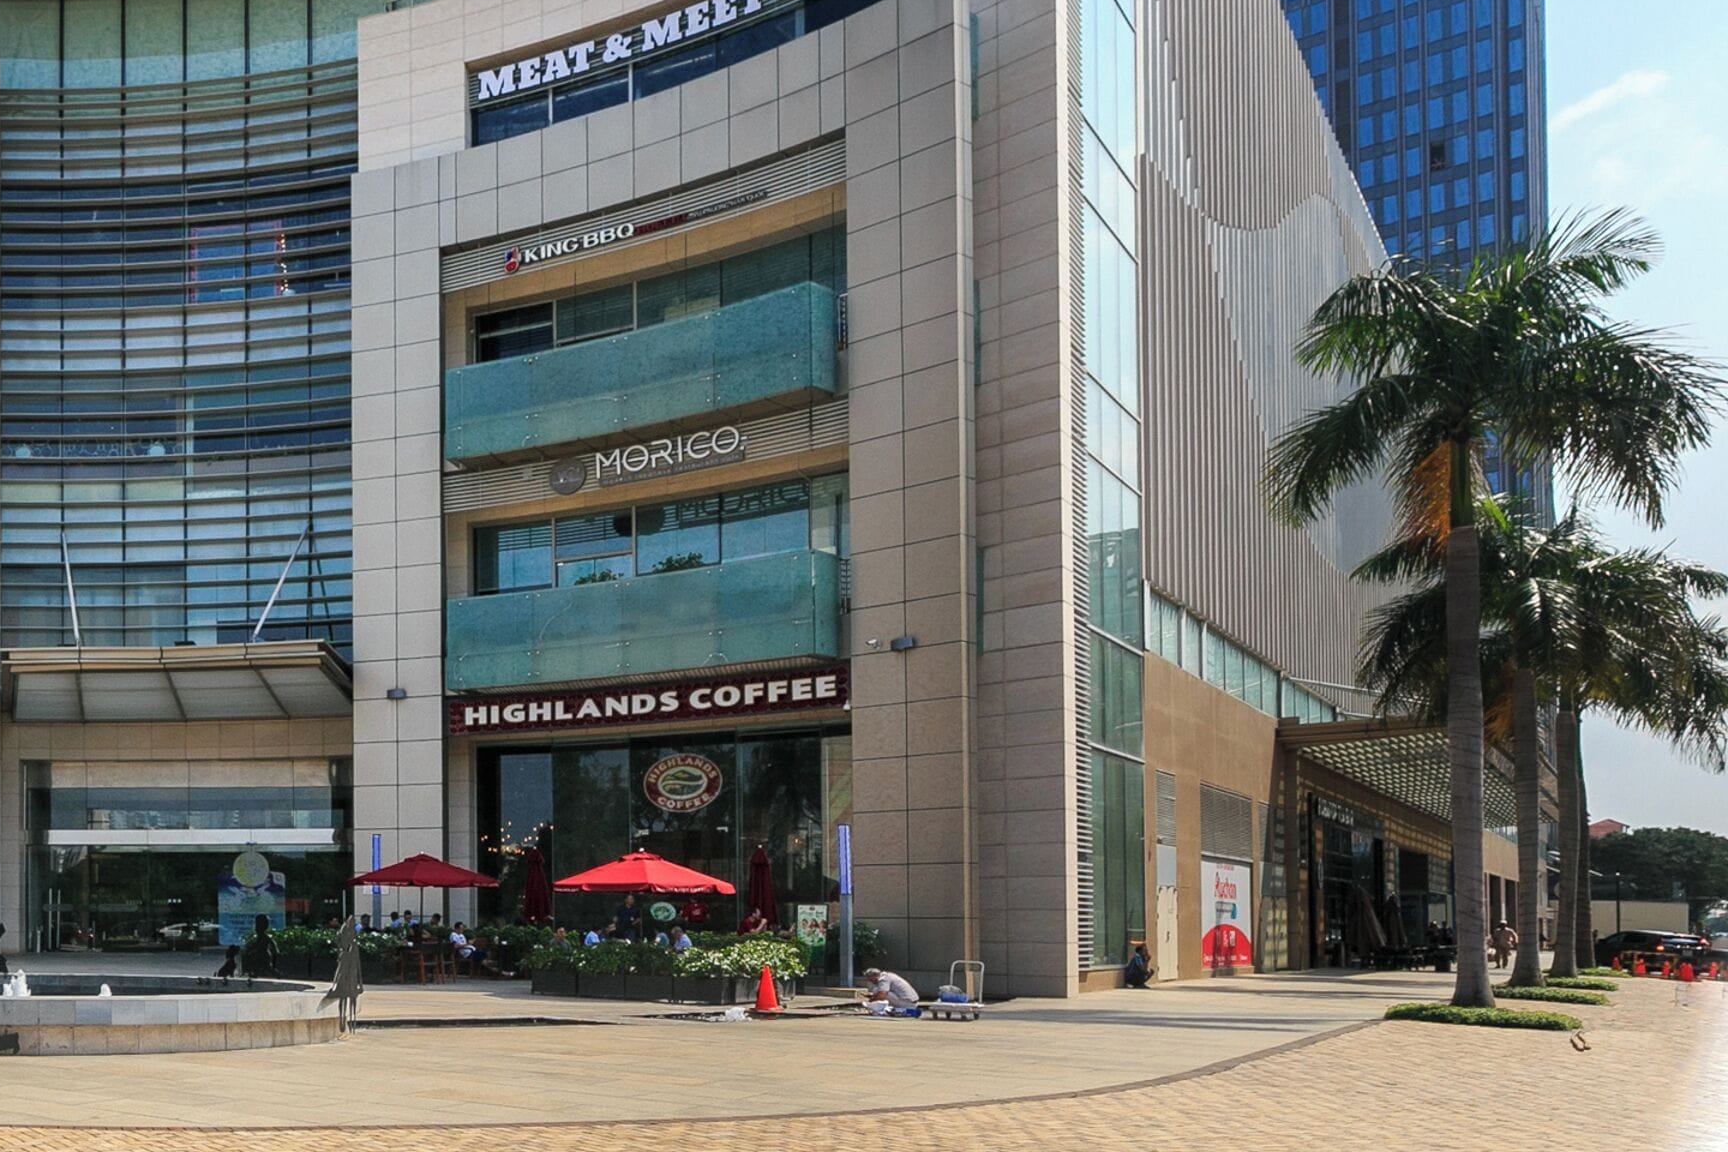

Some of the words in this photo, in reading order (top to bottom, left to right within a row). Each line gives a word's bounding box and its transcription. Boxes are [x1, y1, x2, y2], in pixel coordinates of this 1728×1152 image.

[477, 39, 595, 99] MEAT
[602, 32, 632, 64] &
[524, 237, 579, 264] KING
[582, 222, 635, 249] BBQ
[464, 691, 680, 726] HIGHLANDS
[688, 674, 838, 711] COFFEE
[647, 757, 718, 783] HIGHLANDS
[657, 792, 711, 809] COFFEE
